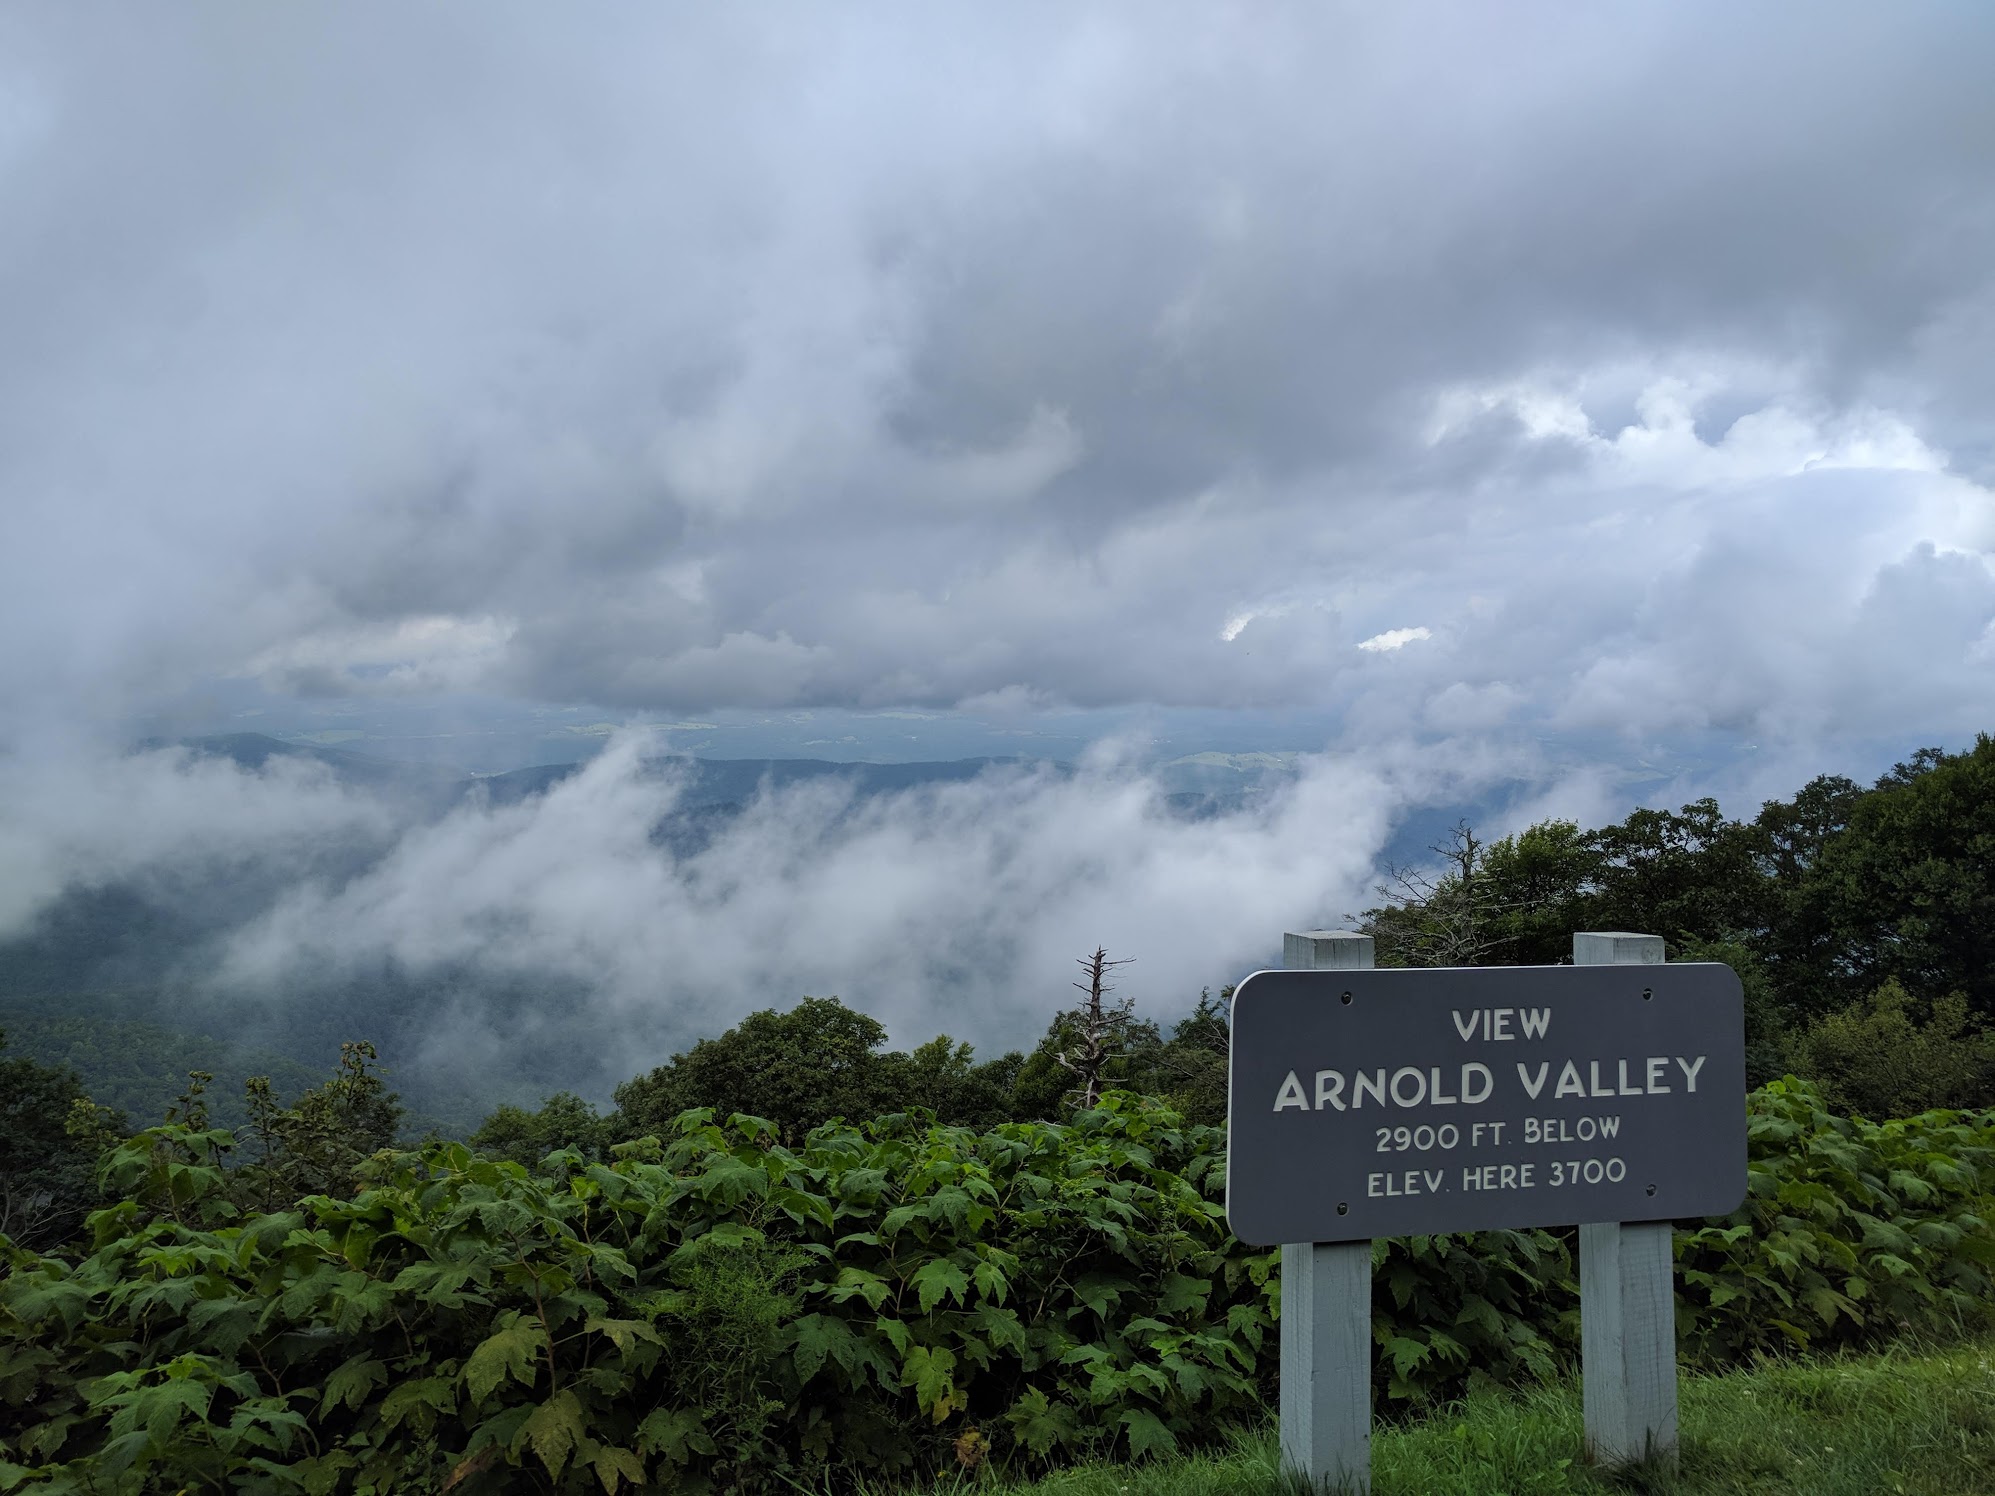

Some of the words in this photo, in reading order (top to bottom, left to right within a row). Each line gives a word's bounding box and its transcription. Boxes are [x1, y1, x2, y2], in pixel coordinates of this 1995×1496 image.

[1452, 1007, 1552, 1042] VIEW
[1273, 1062, 1494, 1112] ARNOLD
[1517, 1055, 1707, 1101] VALLEY
[1376, 1123, 1460, 1152] 2900
[1524, 1115, 1621, 1144] BELOW
[1463, 1163, 1536, 1192] HERE
[1548, 1157, 1627, 1187] 3700
